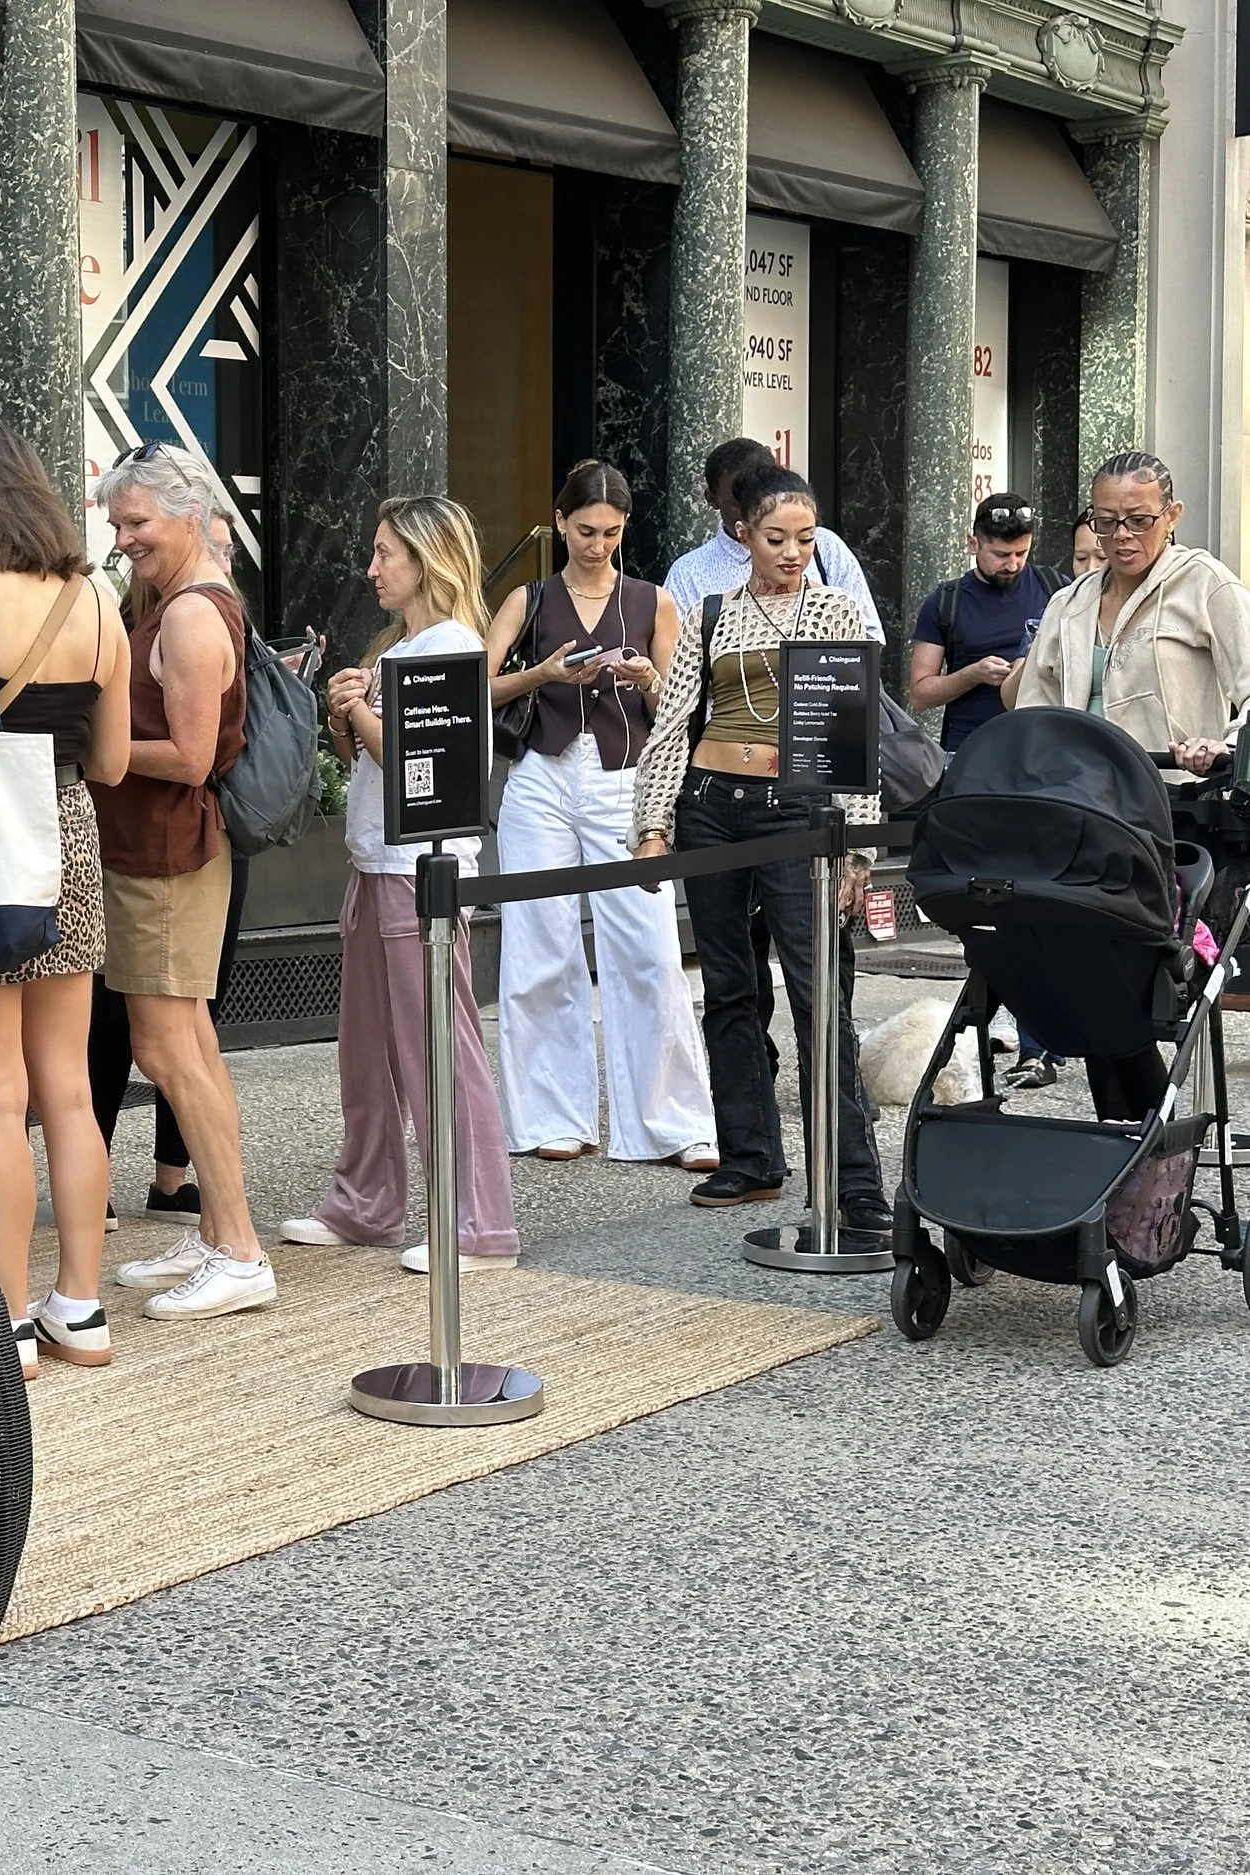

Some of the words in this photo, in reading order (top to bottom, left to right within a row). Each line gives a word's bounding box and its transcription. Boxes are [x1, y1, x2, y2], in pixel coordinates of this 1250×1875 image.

[778, 253, 794, 278] SF
[762, 287, 794, 307] FLOOR
[778, 339, 793, 362] SF
[973, 345, 992, 378] 82
[766, 374, 793, 391] LEVEL
[828, 655, 861, 664] Chainguard
[412, 672, 446, 684] Chainguard
[793, 683, 803, 691] No
[804, 683, 831, 692] Patching
[831, 684, 861, 692] Required.
[404, 706, 431, 717] Caffeine
[431, 704, 450, 714] Here.
[404, 719, 424, 730] Smart
[424, 717, 451, 727] Building
[451, 715, 472, 725] There.
